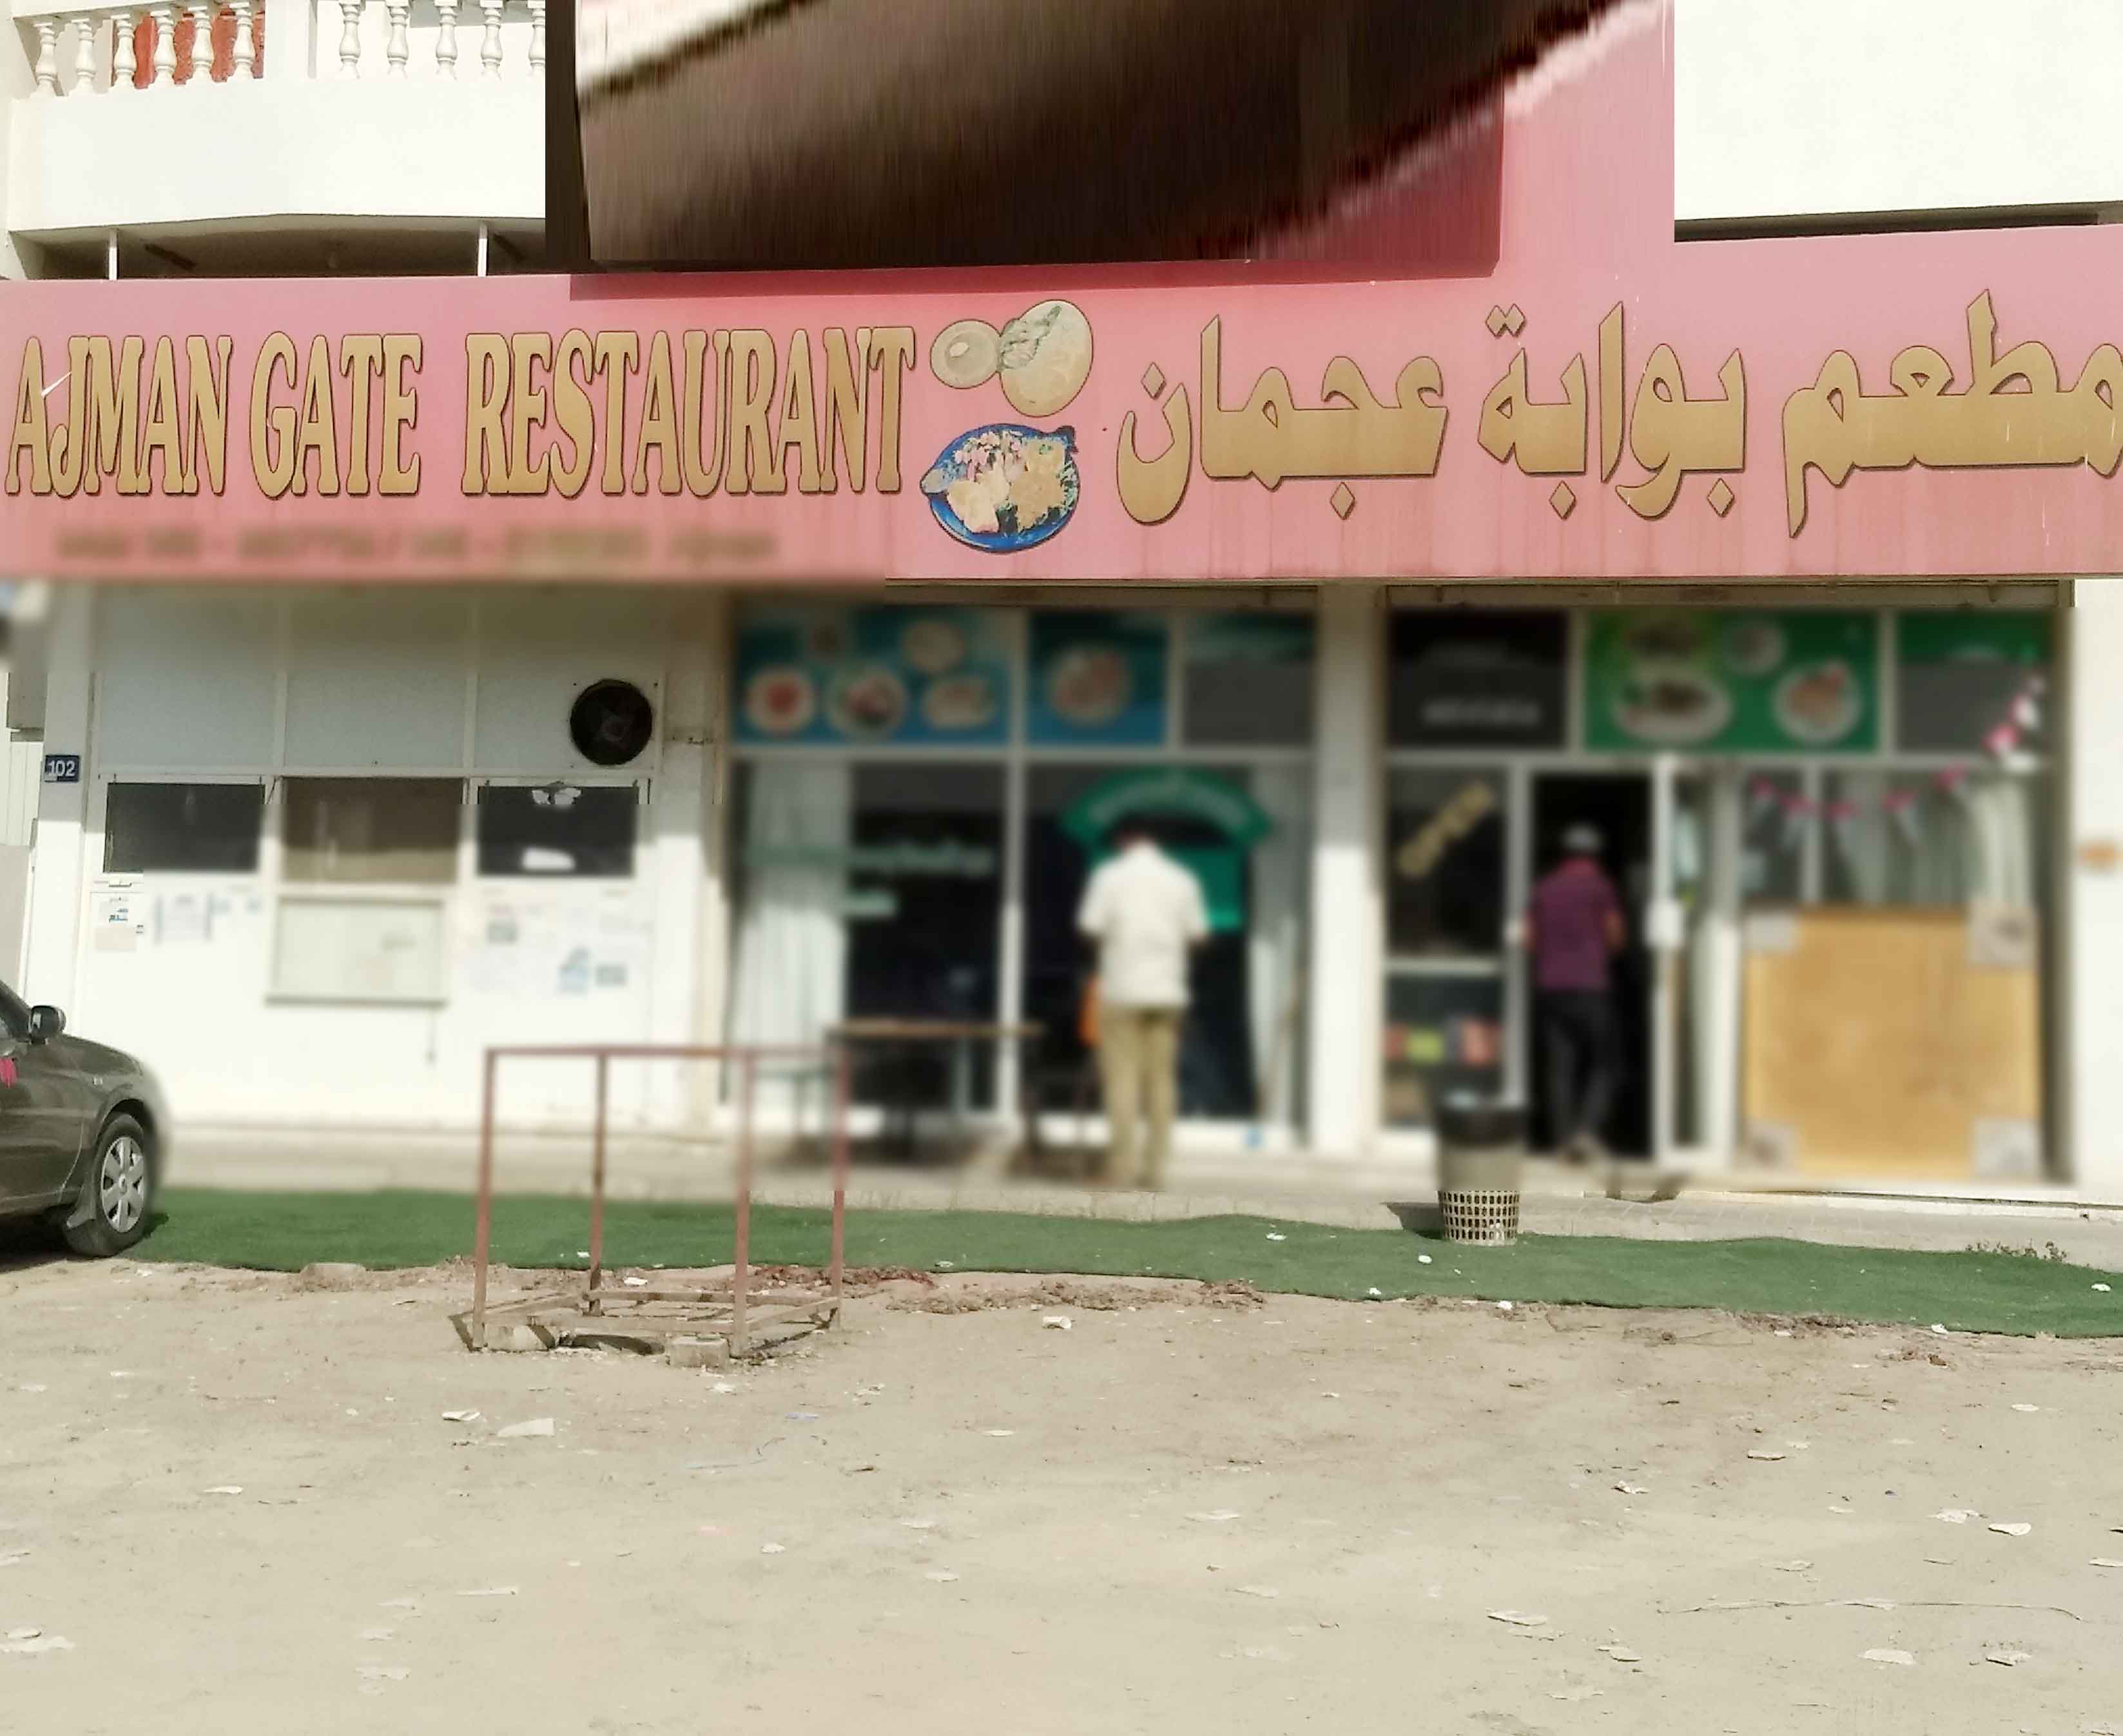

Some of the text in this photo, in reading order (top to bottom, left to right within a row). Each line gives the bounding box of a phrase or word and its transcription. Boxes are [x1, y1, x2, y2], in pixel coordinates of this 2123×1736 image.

[5, 325, 916, 499] AJMAN GATE RESTAURANT
[1116, 288, 2123, 539] مطعم بوابة عجمان
[48, 760, 75, 777] 102
